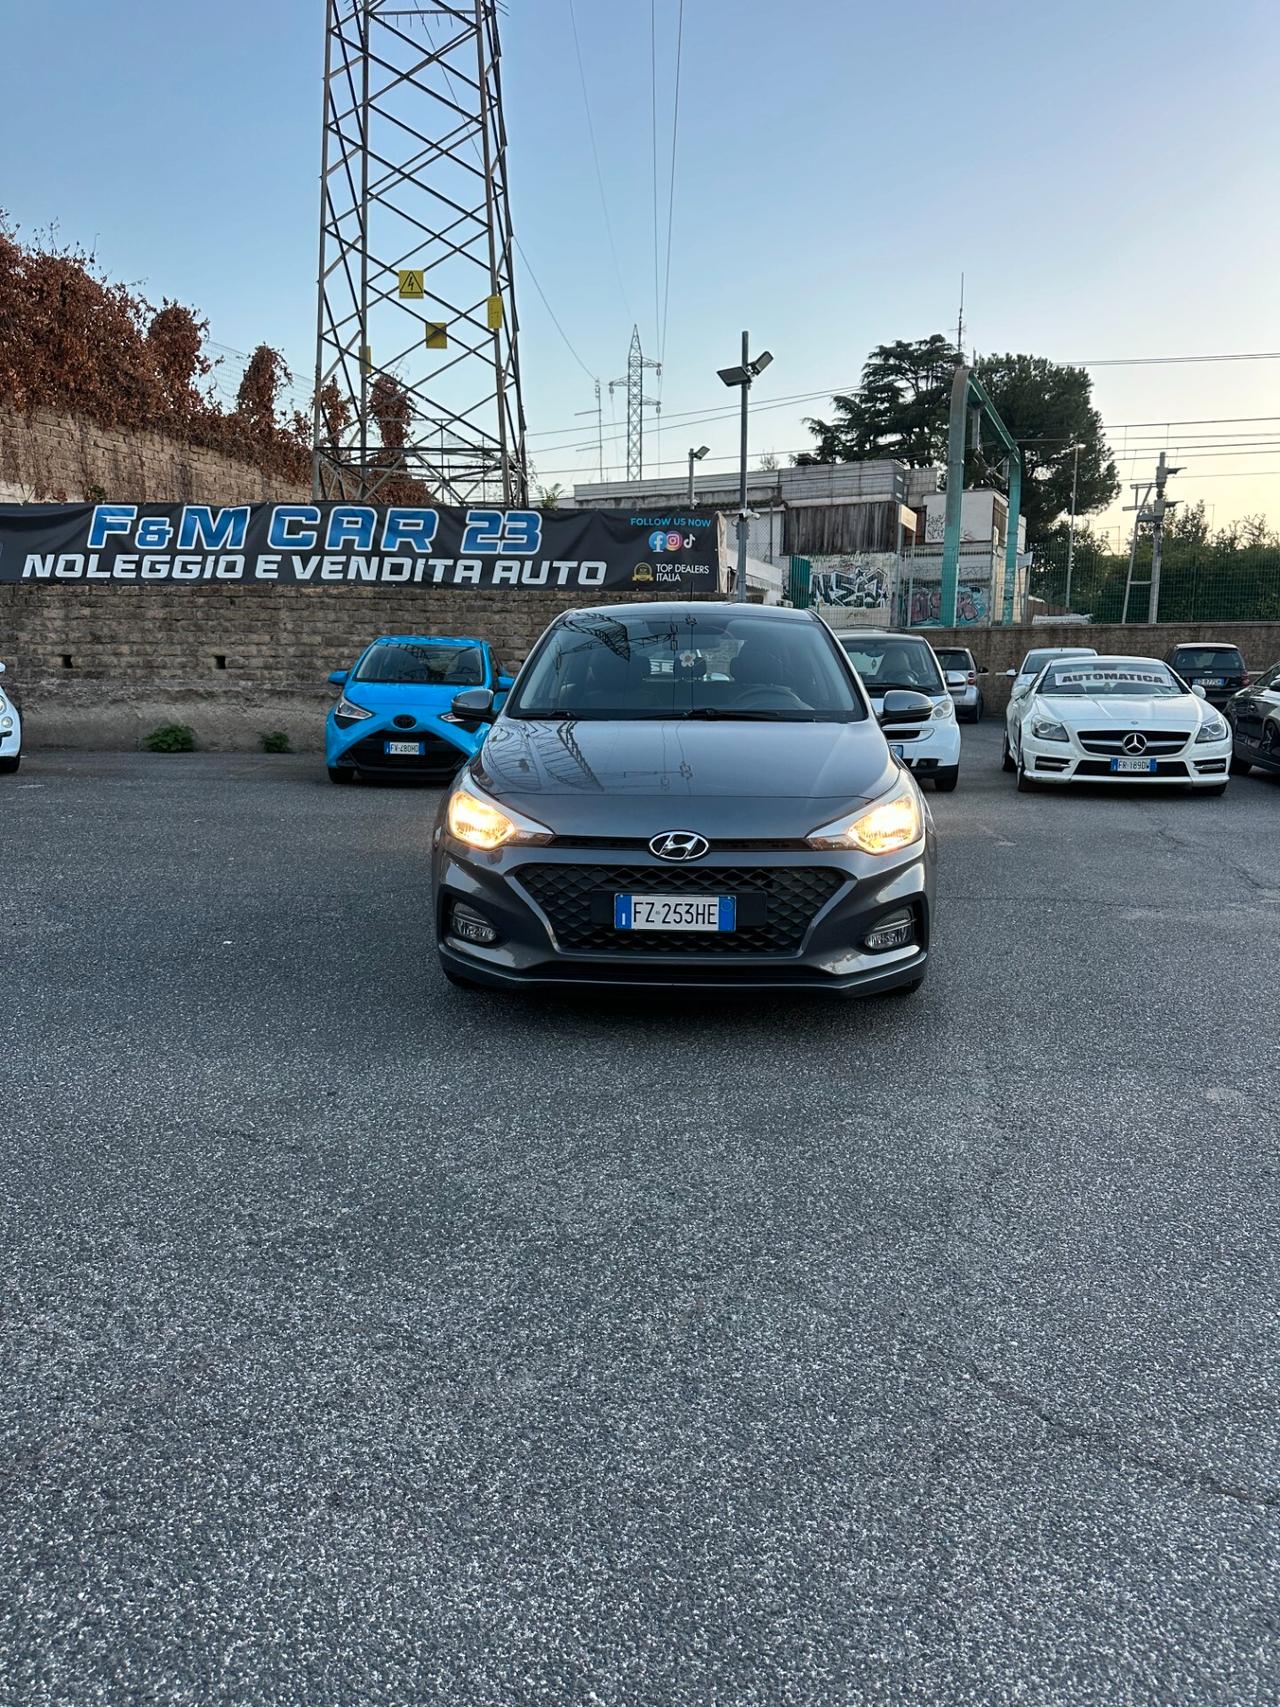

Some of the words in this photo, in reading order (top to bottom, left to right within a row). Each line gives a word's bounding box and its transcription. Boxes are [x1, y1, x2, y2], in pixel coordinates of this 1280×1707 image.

[630, 517, 671, 526] FOLLOW
[673, 517, 686, 526] US
[688, 518, 711, 527] NOW
[87, 504, 250, 551] F&M
[267, 505, 439, 553] CAR
[460, 509, 542, 555] 23
[22, 554, 246, 579] NOLEGGIO
[255, 554, 283, 579] E
[291, 555, 483, 584] VENDITA
[491, 559, 608, 585] AUTO
[656, 564, 673, 573] TOP
[675, 564, 710, 574] DEALERS
[656, 573, 681, 582] ITALIA
[1062, 672, 1164, 684] AUTOMATICA
[633, 901, 655, 923] FZ
[661, 902, 718, 925] 253HE
